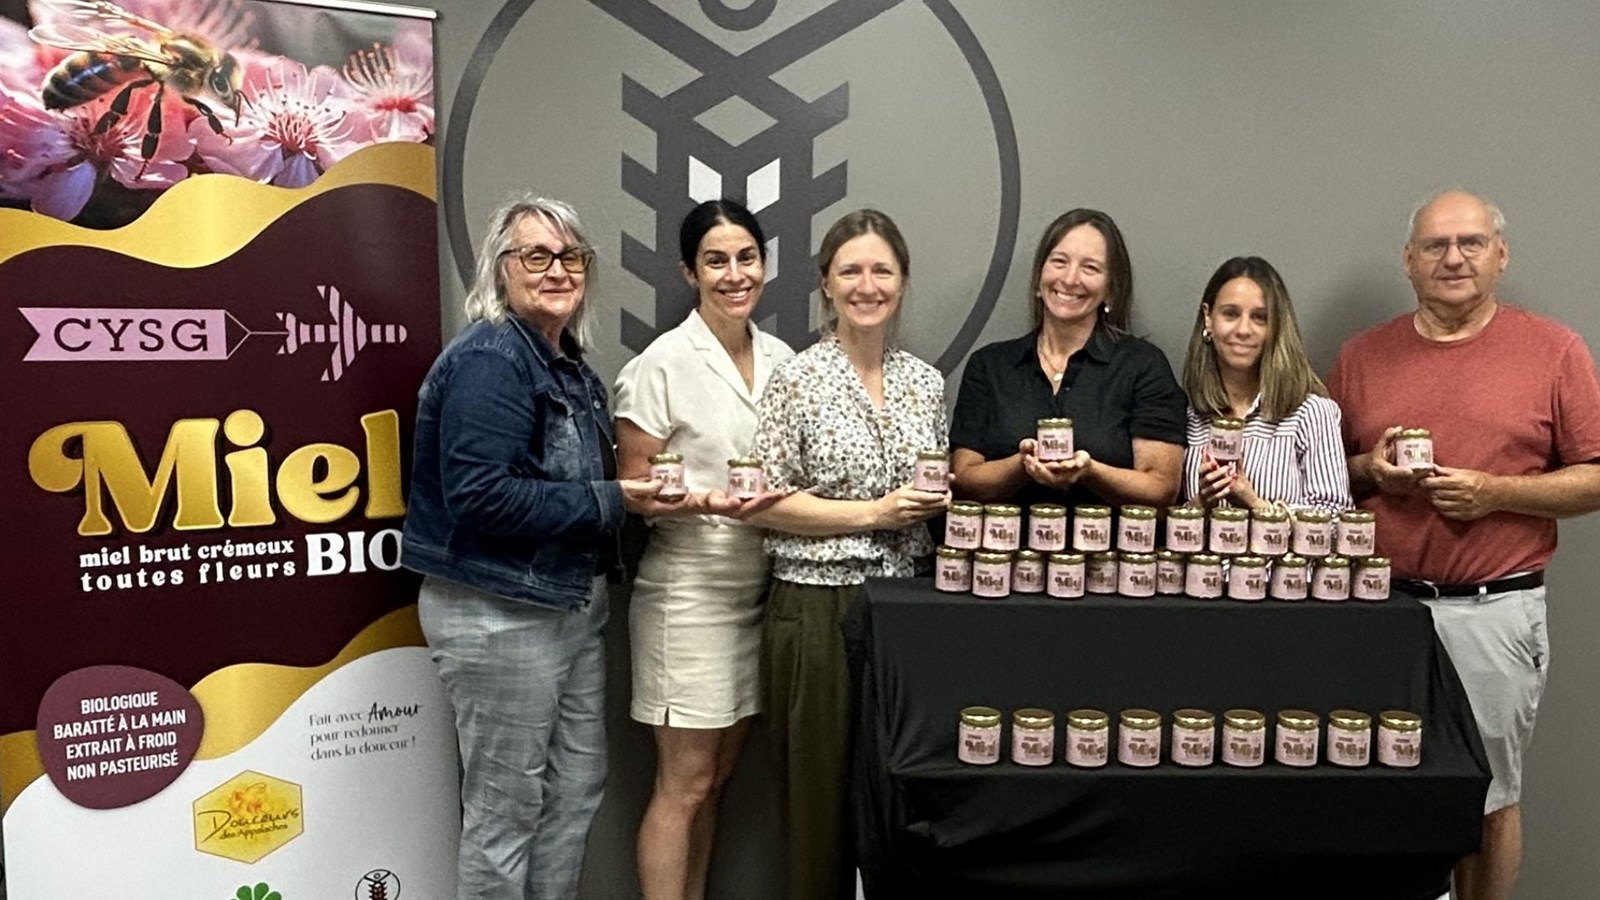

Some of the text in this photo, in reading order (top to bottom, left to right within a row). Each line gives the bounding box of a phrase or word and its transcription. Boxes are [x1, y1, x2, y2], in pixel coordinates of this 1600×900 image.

[53, 318, 209, 353] CYSG
[28, 408, 407, 537] Miel
[79, 538, 295, 568] miel brut crémeux
[305, 528, 403, 577] BIO
[80, 560, 296, 592] toutes fleurs
[80, 691, 158, 715] BIOLOGIQUE
[309, 702, 424, 727] Fait avec Amour
[53, 709, 186, 739] BARATTÉ À LA MAIN
[310, 723, 399, 747] pour redonner
[66, 731, 177, 760] EXTRAIT À FROID
[311, 747, 342, 761] dans
[345, 744, 357, 756] la
[359, 738, 410, 754] douceur
[67, 749, 179, 781] NON PASTEURISÉ
[197, 808, 299, 843] Douceurs
